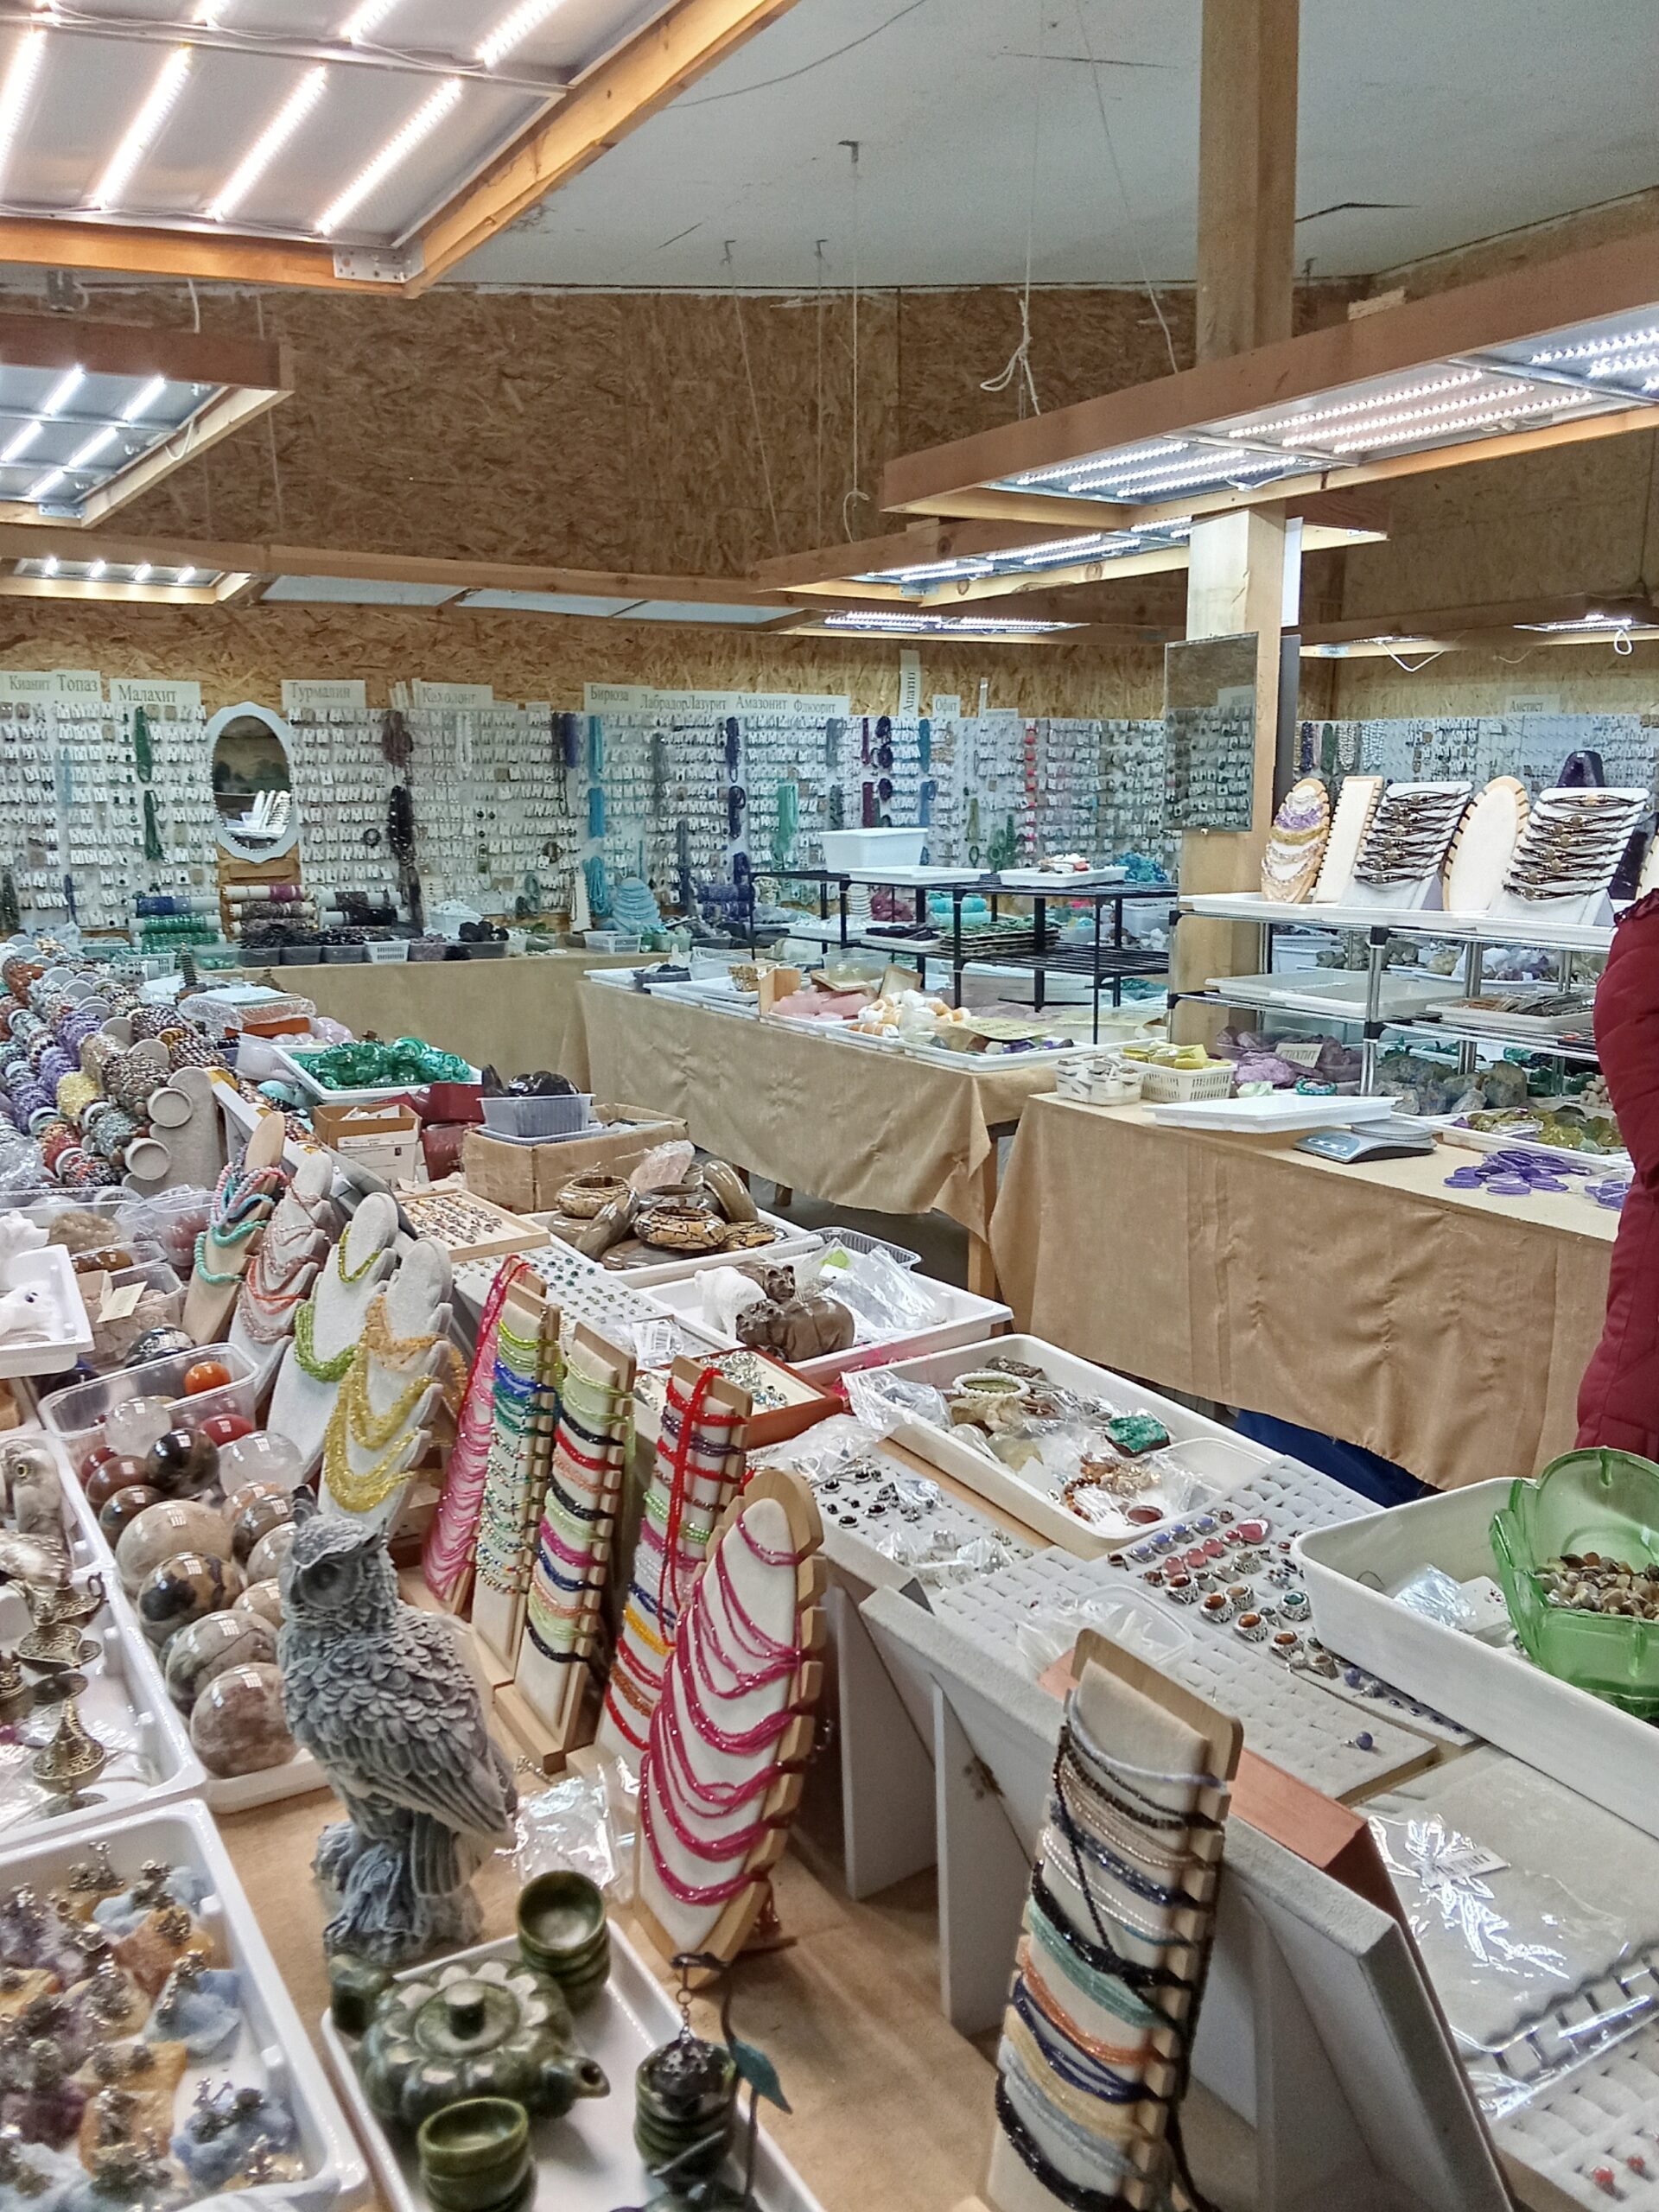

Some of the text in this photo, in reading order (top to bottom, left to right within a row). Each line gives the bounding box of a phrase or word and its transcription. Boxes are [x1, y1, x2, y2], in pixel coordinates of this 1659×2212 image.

[57, 674, 98, 692] Топаз
[290, 683, 350, 701] Турмалин
[118, 684, 177, 703] Малахит
[590, 685, 629, 703] Бирюза
[640, 695, 689, 712] Лабрадор
[735, 695, 788, 711] Амазонит
[793, 697, 836, 715] Флюорит
